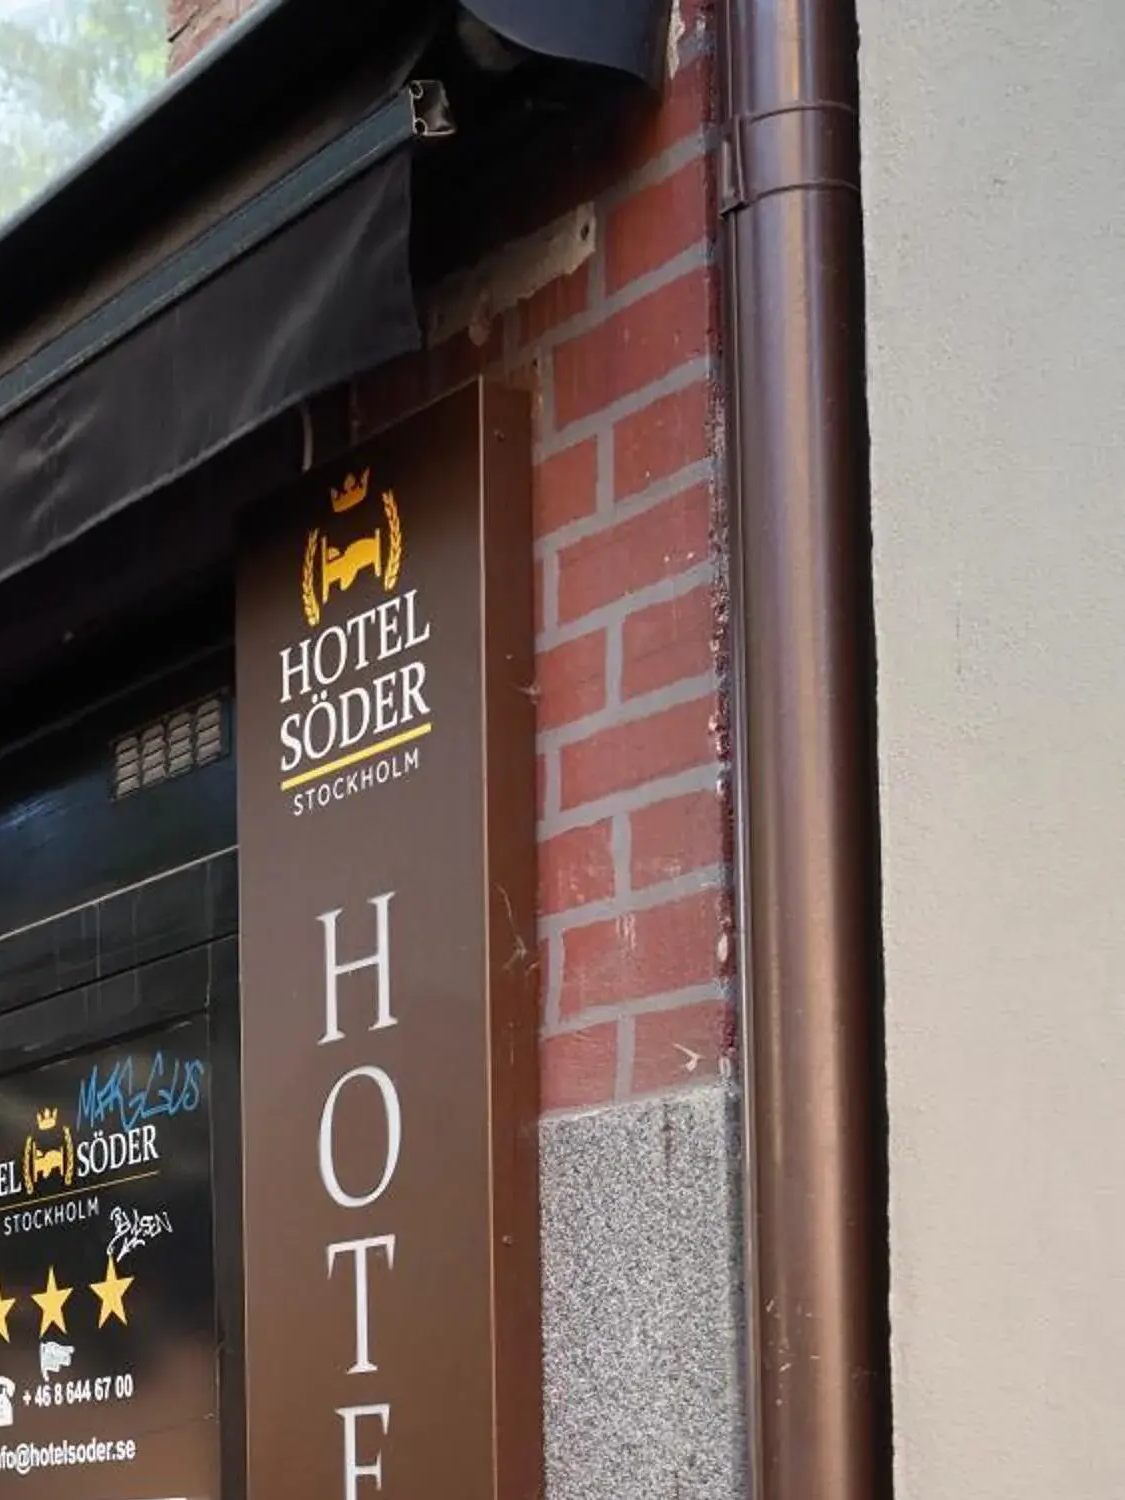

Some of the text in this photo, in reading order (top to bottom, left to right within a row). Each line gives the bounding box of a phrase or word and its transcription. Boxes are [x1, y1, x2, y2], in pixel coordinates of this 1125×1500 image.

[279, 589, 431, 703] HOTEL
[280, 661, 431, 771] SÖDER
[293, 748, 420, 816] STOCKHOLM
[77, 1123, 160, 1178] SÖDER
[4, 1196, 100, 1236] STOCKHOLM
[54, 1382, 62, 1405] 8
[66, 1379, 91, 1405] 644
[94, 1376, 112, 1400] 67
[115, 1373, 134, 1399] 00
